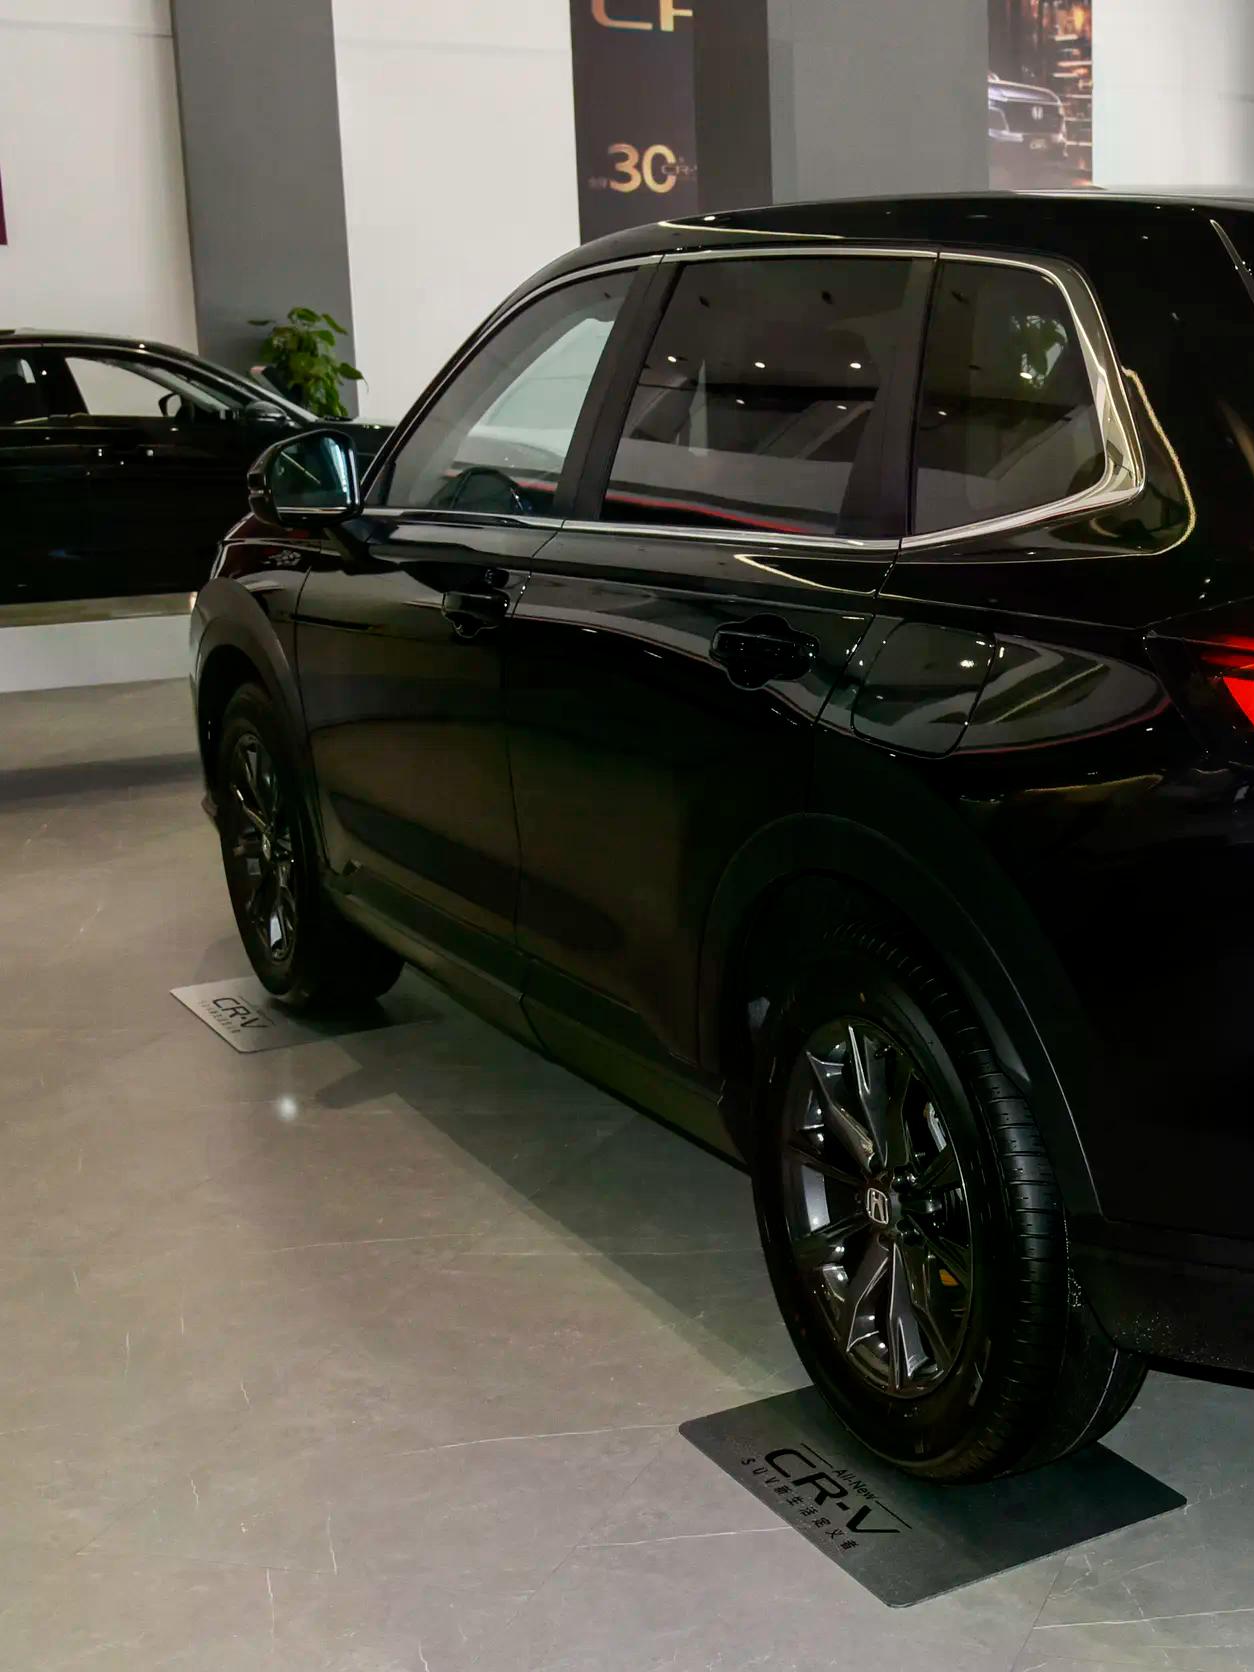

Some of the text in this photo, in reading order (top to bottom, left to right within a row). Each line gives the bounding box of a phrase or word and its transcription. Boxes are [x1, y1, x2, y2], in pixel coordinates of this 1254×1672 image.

[608, 143, 677, 193] 30
[213, 997, 268, 1029] CR-V
[764, 1448, 901, 1534] CR-V
[832, 1467, 880, 1502] All-New
